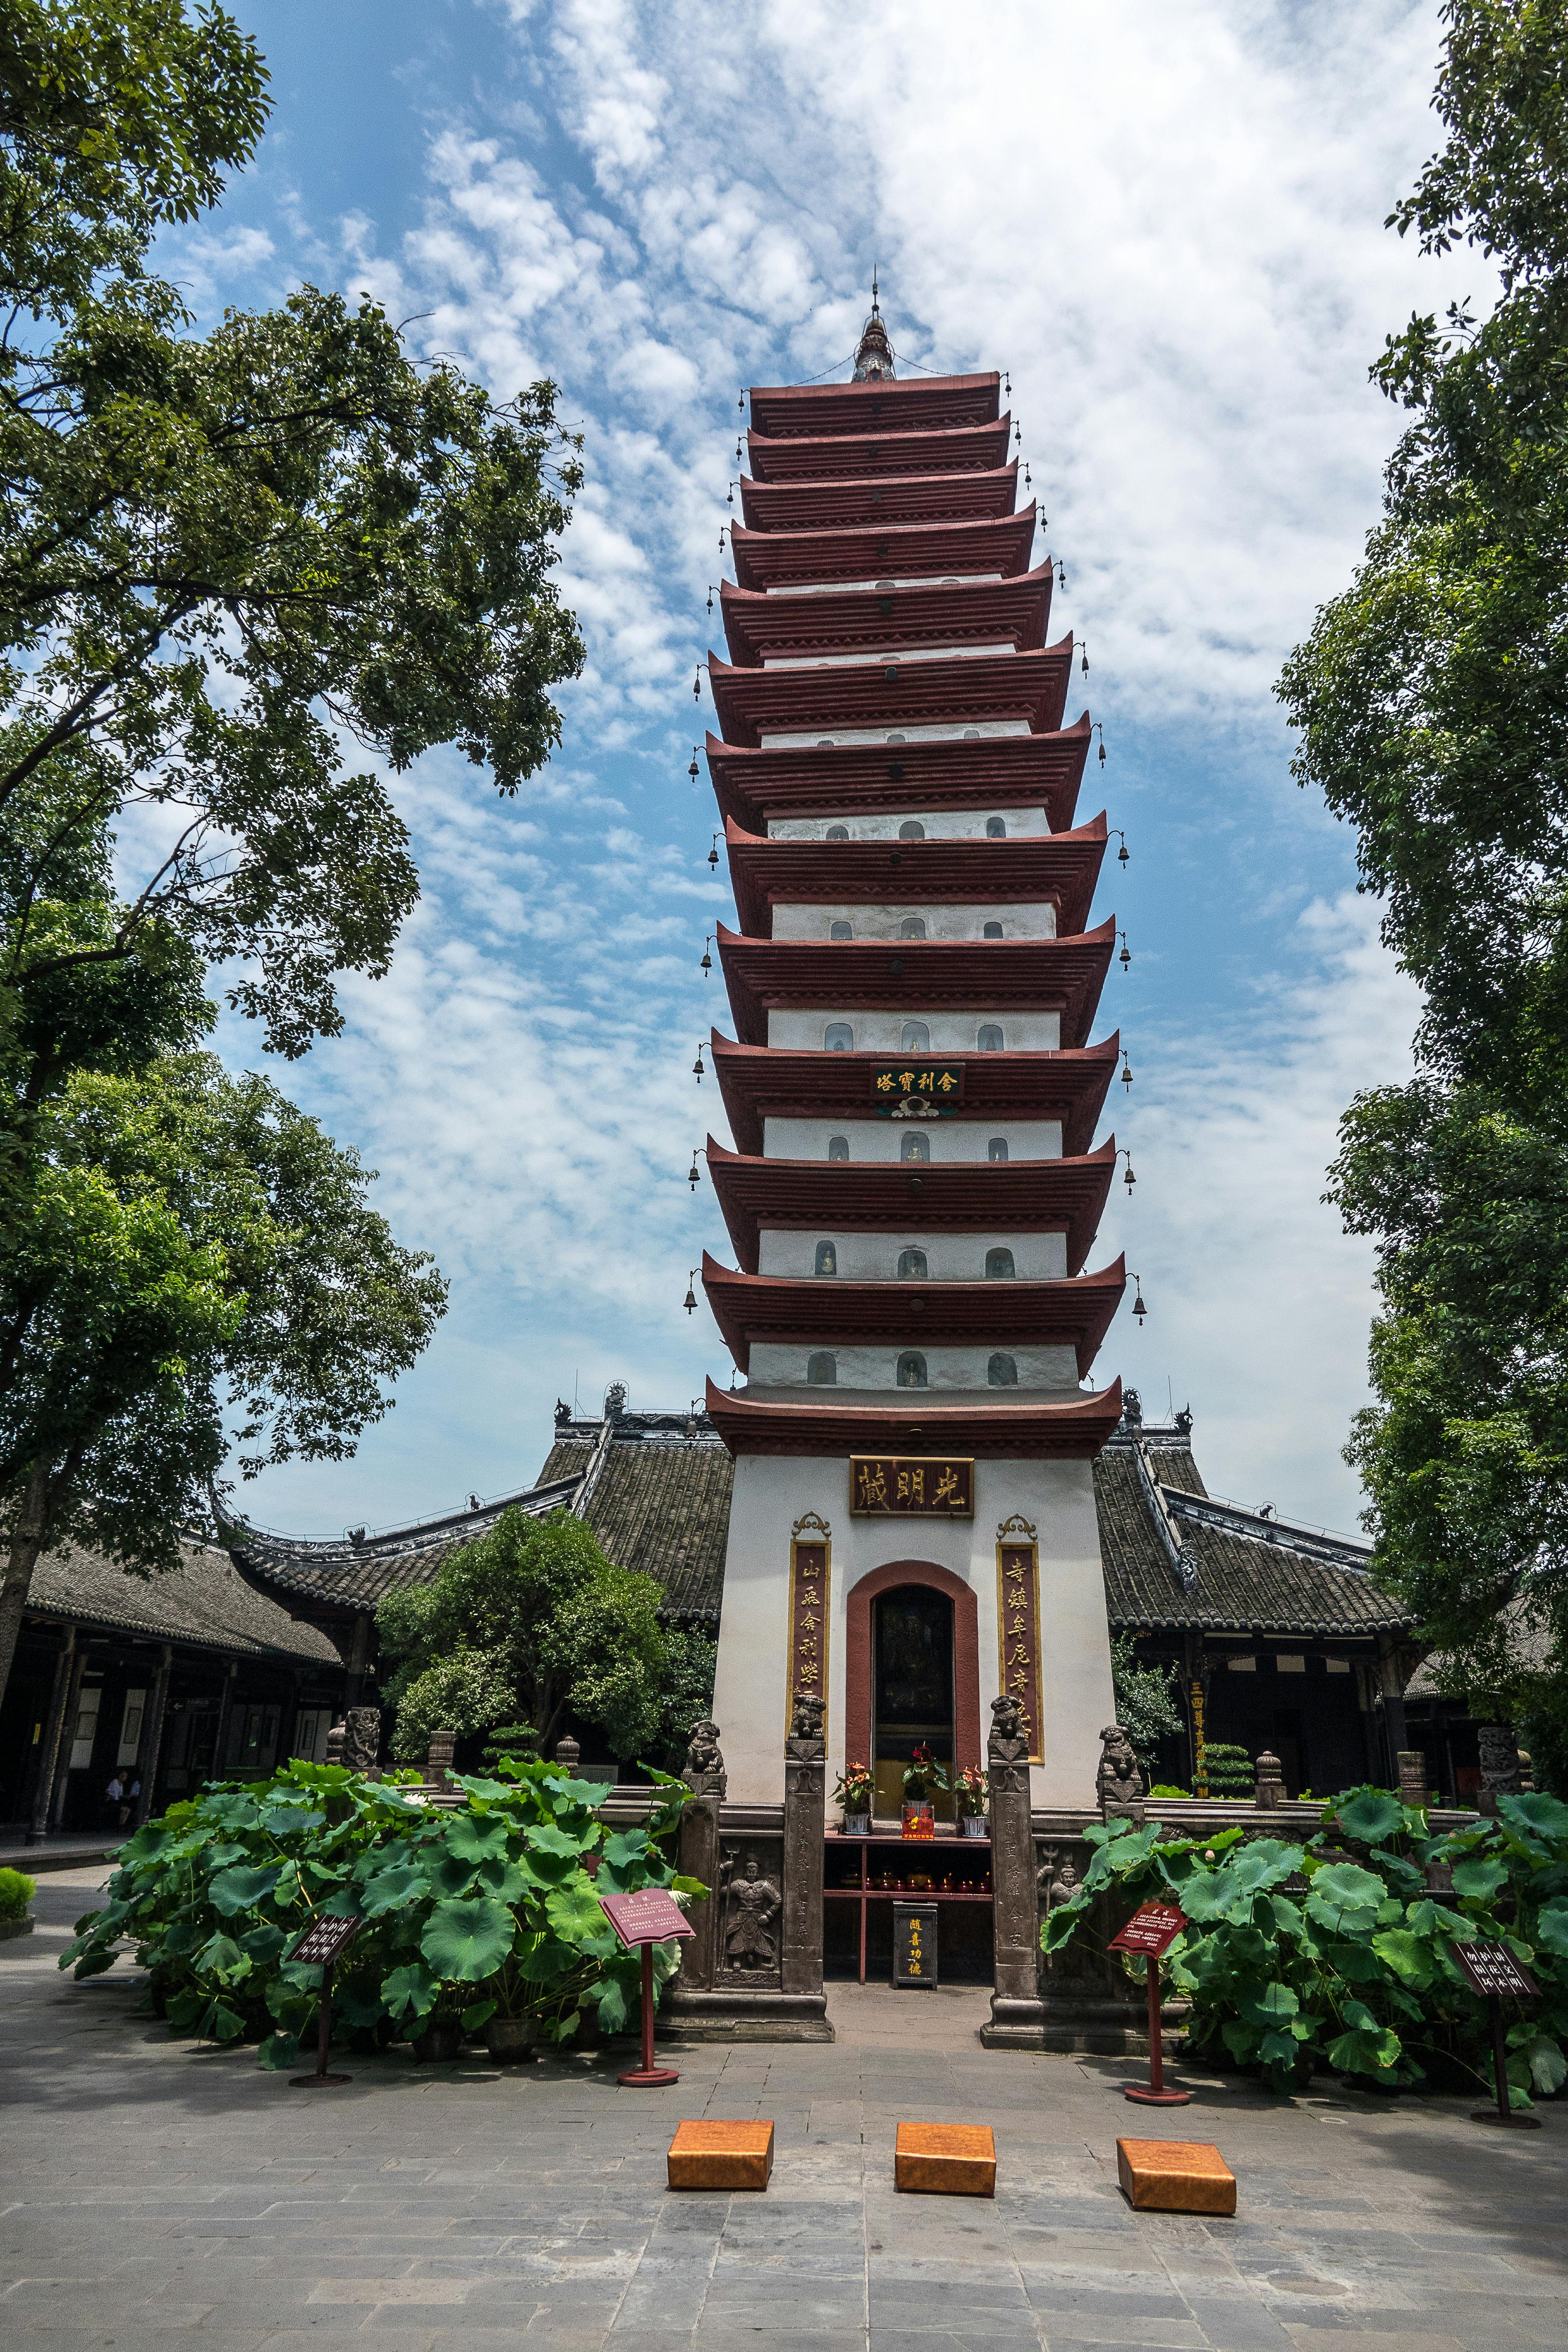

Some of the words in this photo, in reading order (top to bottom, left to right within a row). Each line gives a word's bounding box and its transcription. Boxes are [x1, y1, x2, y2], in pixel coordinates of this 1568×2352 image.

[876, 1072, 958, 1092] 舍利寶塔
[1493, 1952, 1522, 1987] 讲文明
